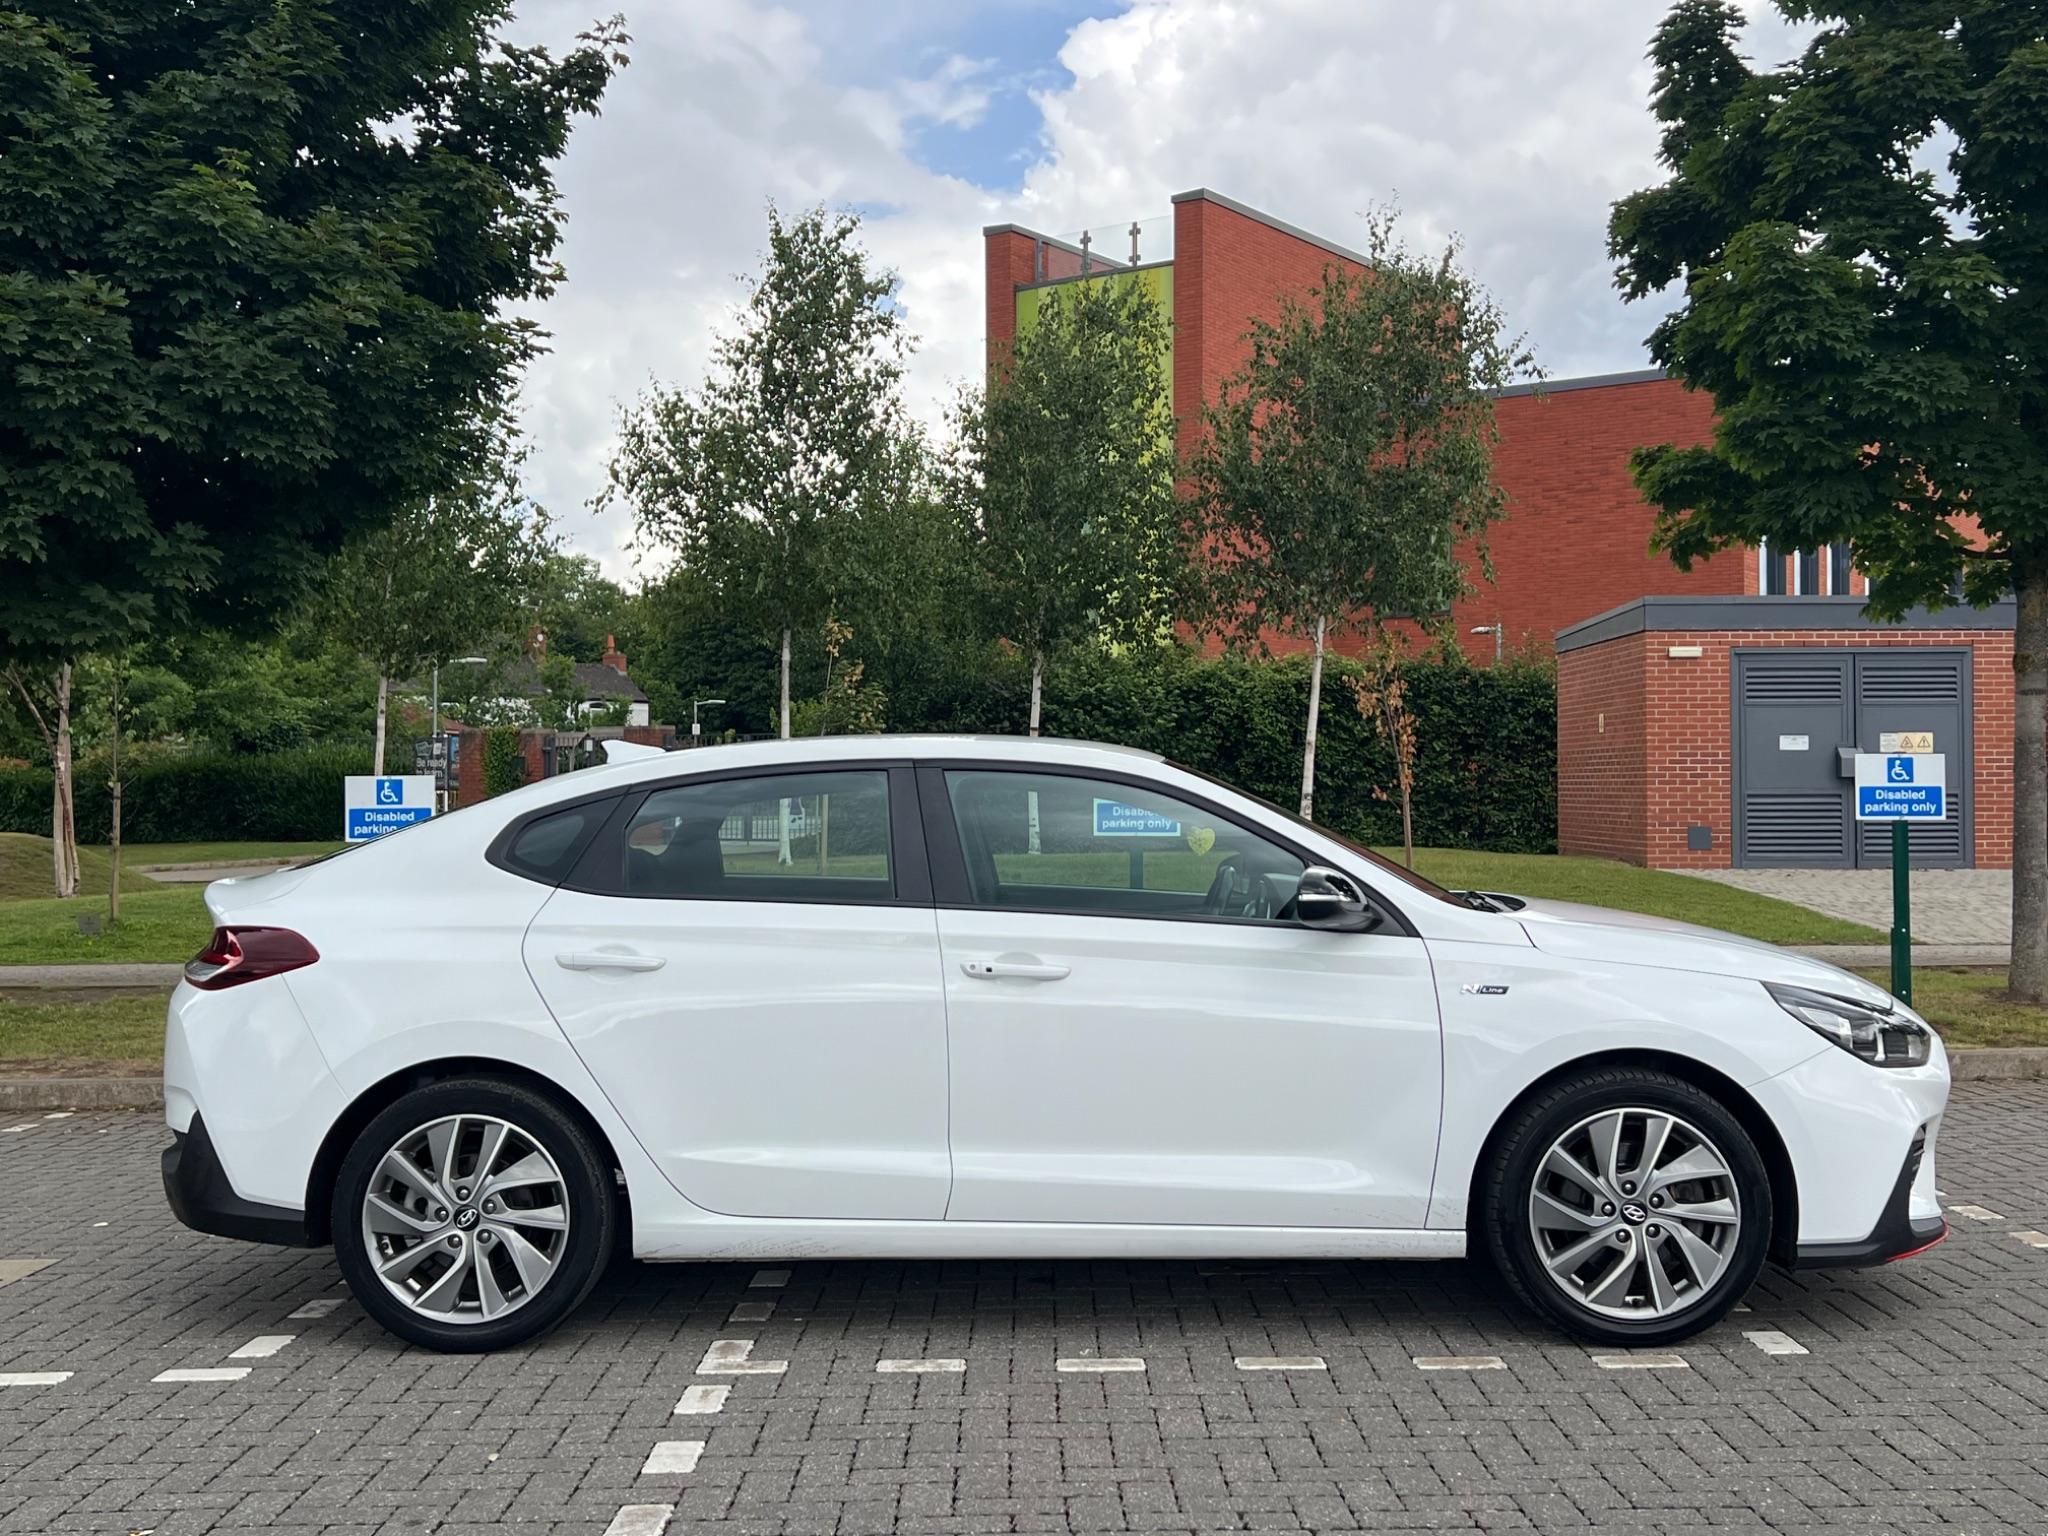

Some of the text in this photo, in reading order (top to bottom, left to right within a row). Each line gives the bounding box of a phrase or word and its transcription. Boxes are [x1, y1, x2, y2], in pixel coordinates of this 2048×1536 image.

[416, 757, 447, 769] Be ready
[1875, 789, 1926, 800] Disabled
[1112, 806, 1159, 817] Disable
[1864, 802, 1937, 814] parking only
[364, 811, 415, 822] Disabled
[1102, 818, 1172, 830] parking only
